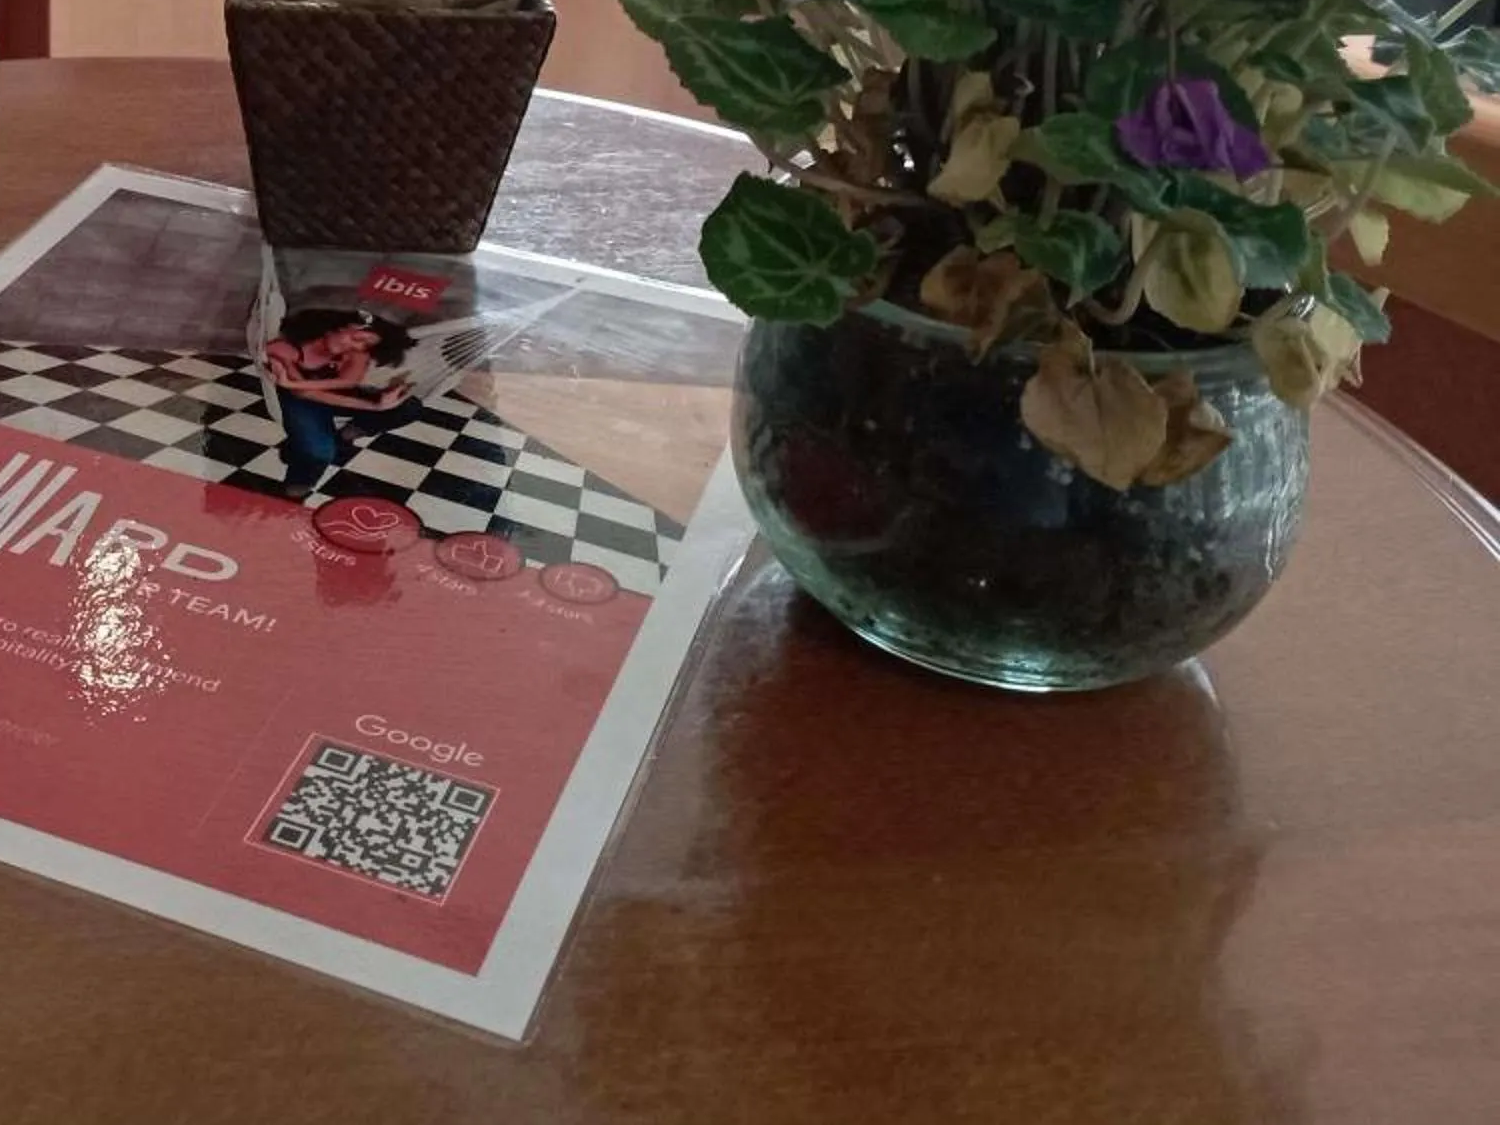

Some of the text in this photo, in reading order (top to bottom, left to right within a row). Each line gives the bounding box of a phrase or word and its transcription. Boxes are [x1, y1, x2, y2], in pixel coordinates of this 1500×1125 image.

[373, 275, 433, 300] ibis
[170, 587, 278, 634] TEAM!
[355, 714, 485, 767] Google
